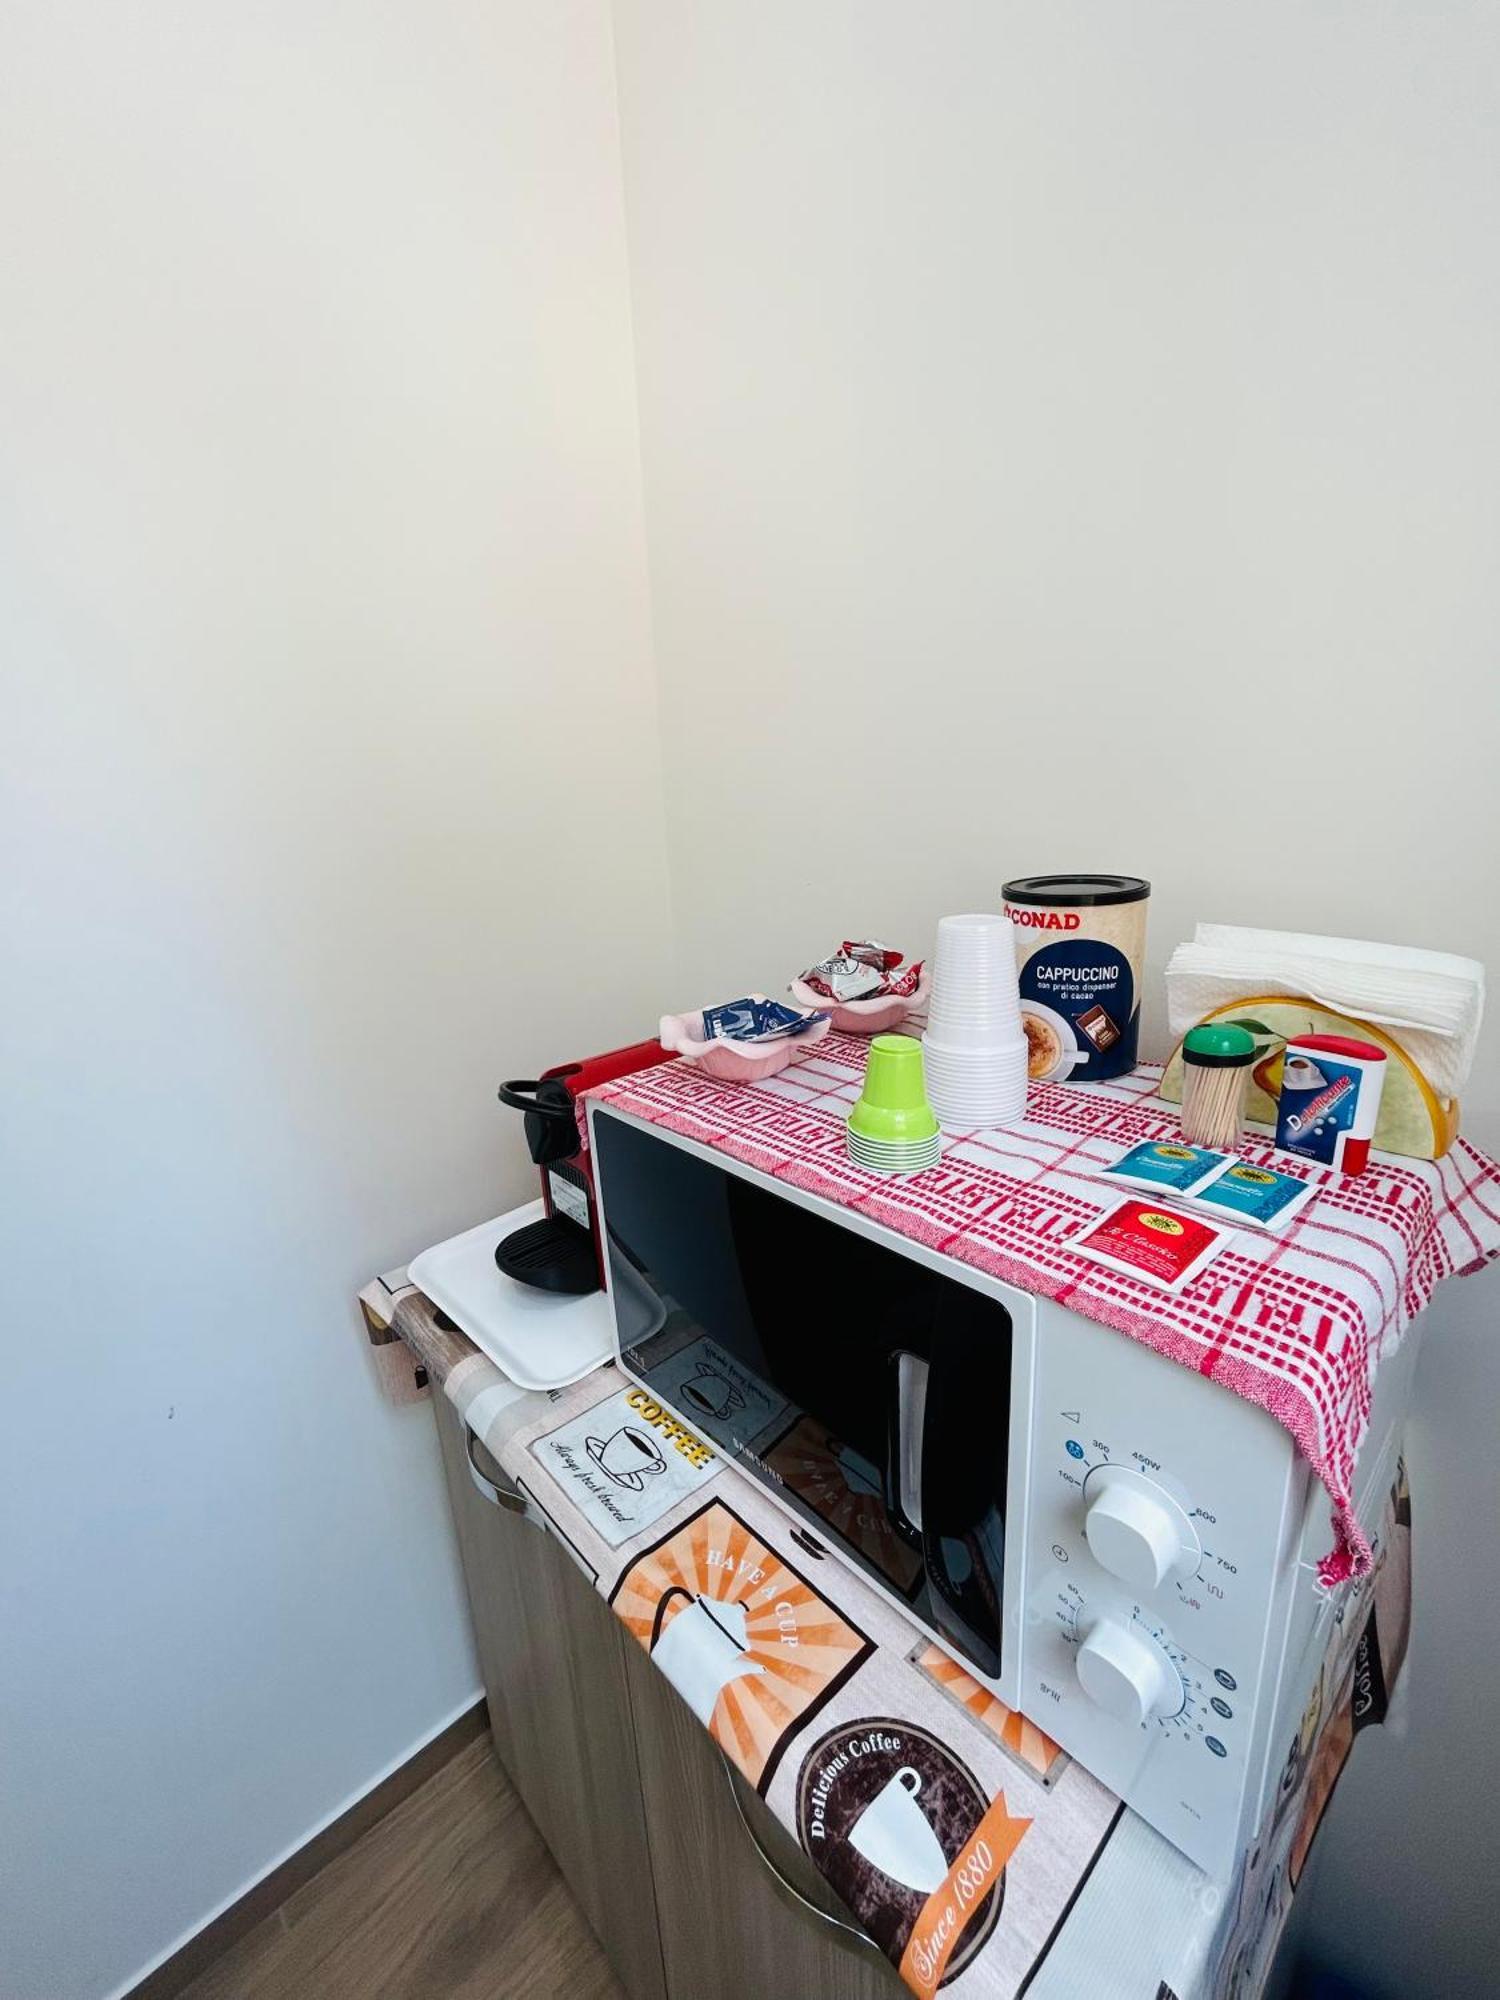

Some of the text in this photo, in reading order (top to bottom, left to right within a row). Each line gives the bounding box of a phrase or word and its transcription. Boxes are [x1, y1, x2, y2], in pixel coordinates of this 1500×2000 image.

[1011, 911, 1081, 931] CONAD
[1036, 965, 1119, 982] CAPPUCCINO
[1052, 983, 1080, 992] pratico
[1061, 991, 1094, 1000] di cacao
[625, 1388, 716, 1470] COFFEE
[1092, 1439, 1110, 1454] 300
[1131, 1451, 1162, 1471] 450W
[1058, 1469, 1074, 1484] 100
[1216, 1557, 1238, 1575] 750
[705, 1549, 799, 1649] HAVE A CUP
[811, 1732, 901, 1840] Delicious Coffee
[911, 1839, 993, 1989] Since 1880
